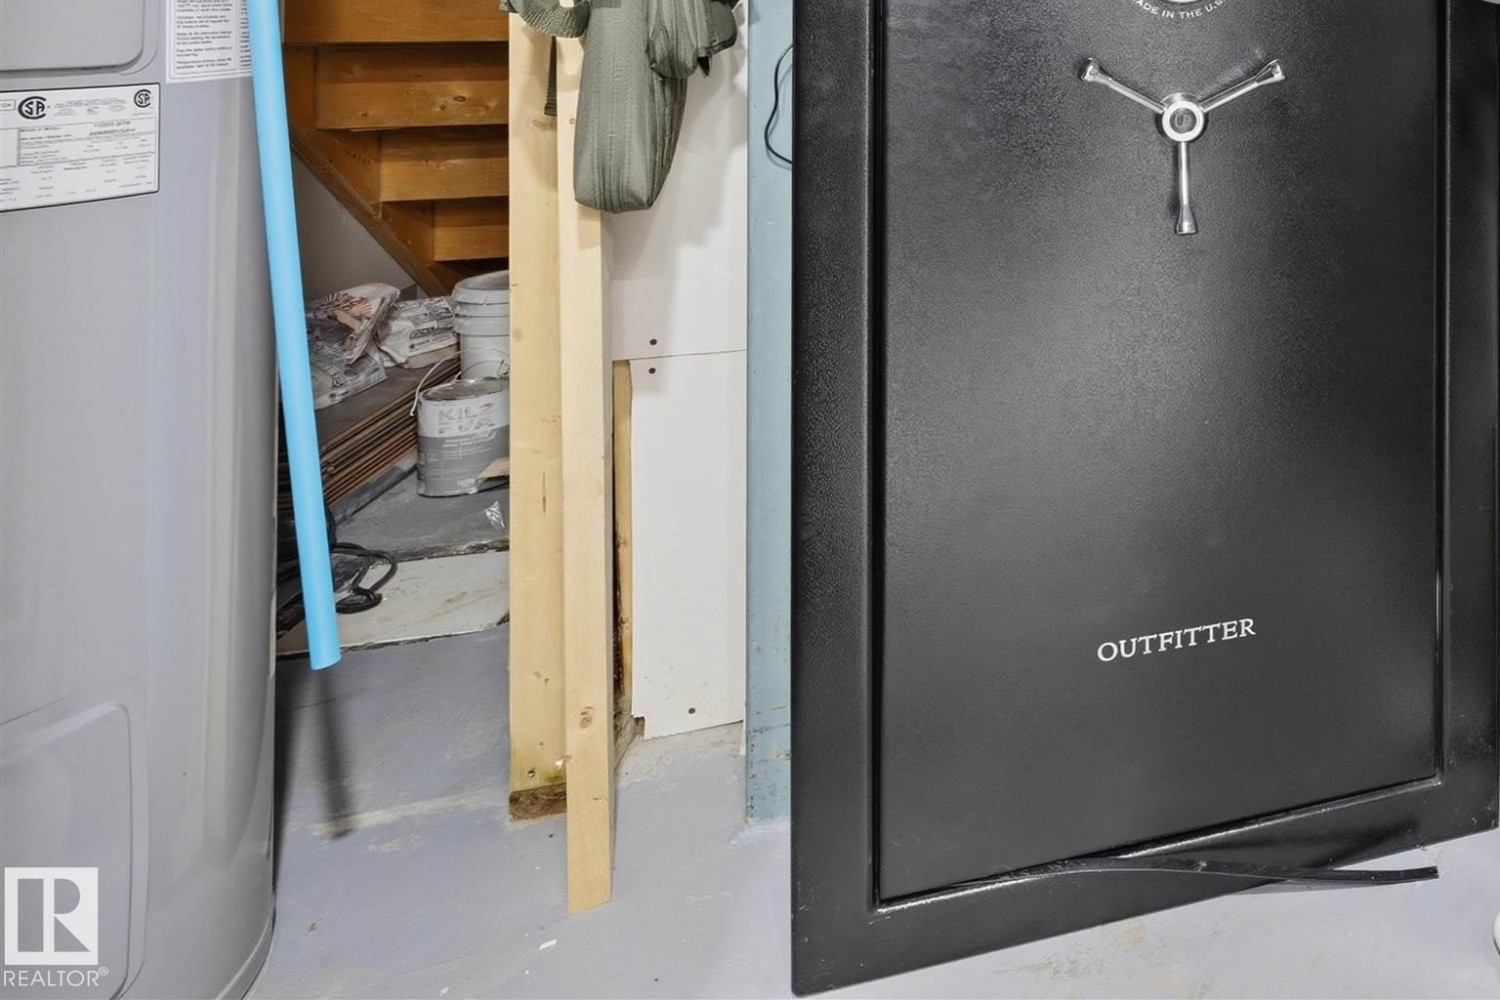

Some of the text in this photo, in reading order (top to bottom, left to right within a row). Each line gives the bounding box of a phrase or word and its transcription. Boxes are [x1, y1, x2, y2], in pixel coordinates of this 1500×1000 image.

[1161, 10, 1175, 19] IN
[1179, 8, 1203, 19] THE
[1097, 618, 1257, 662] OUTFITTER
